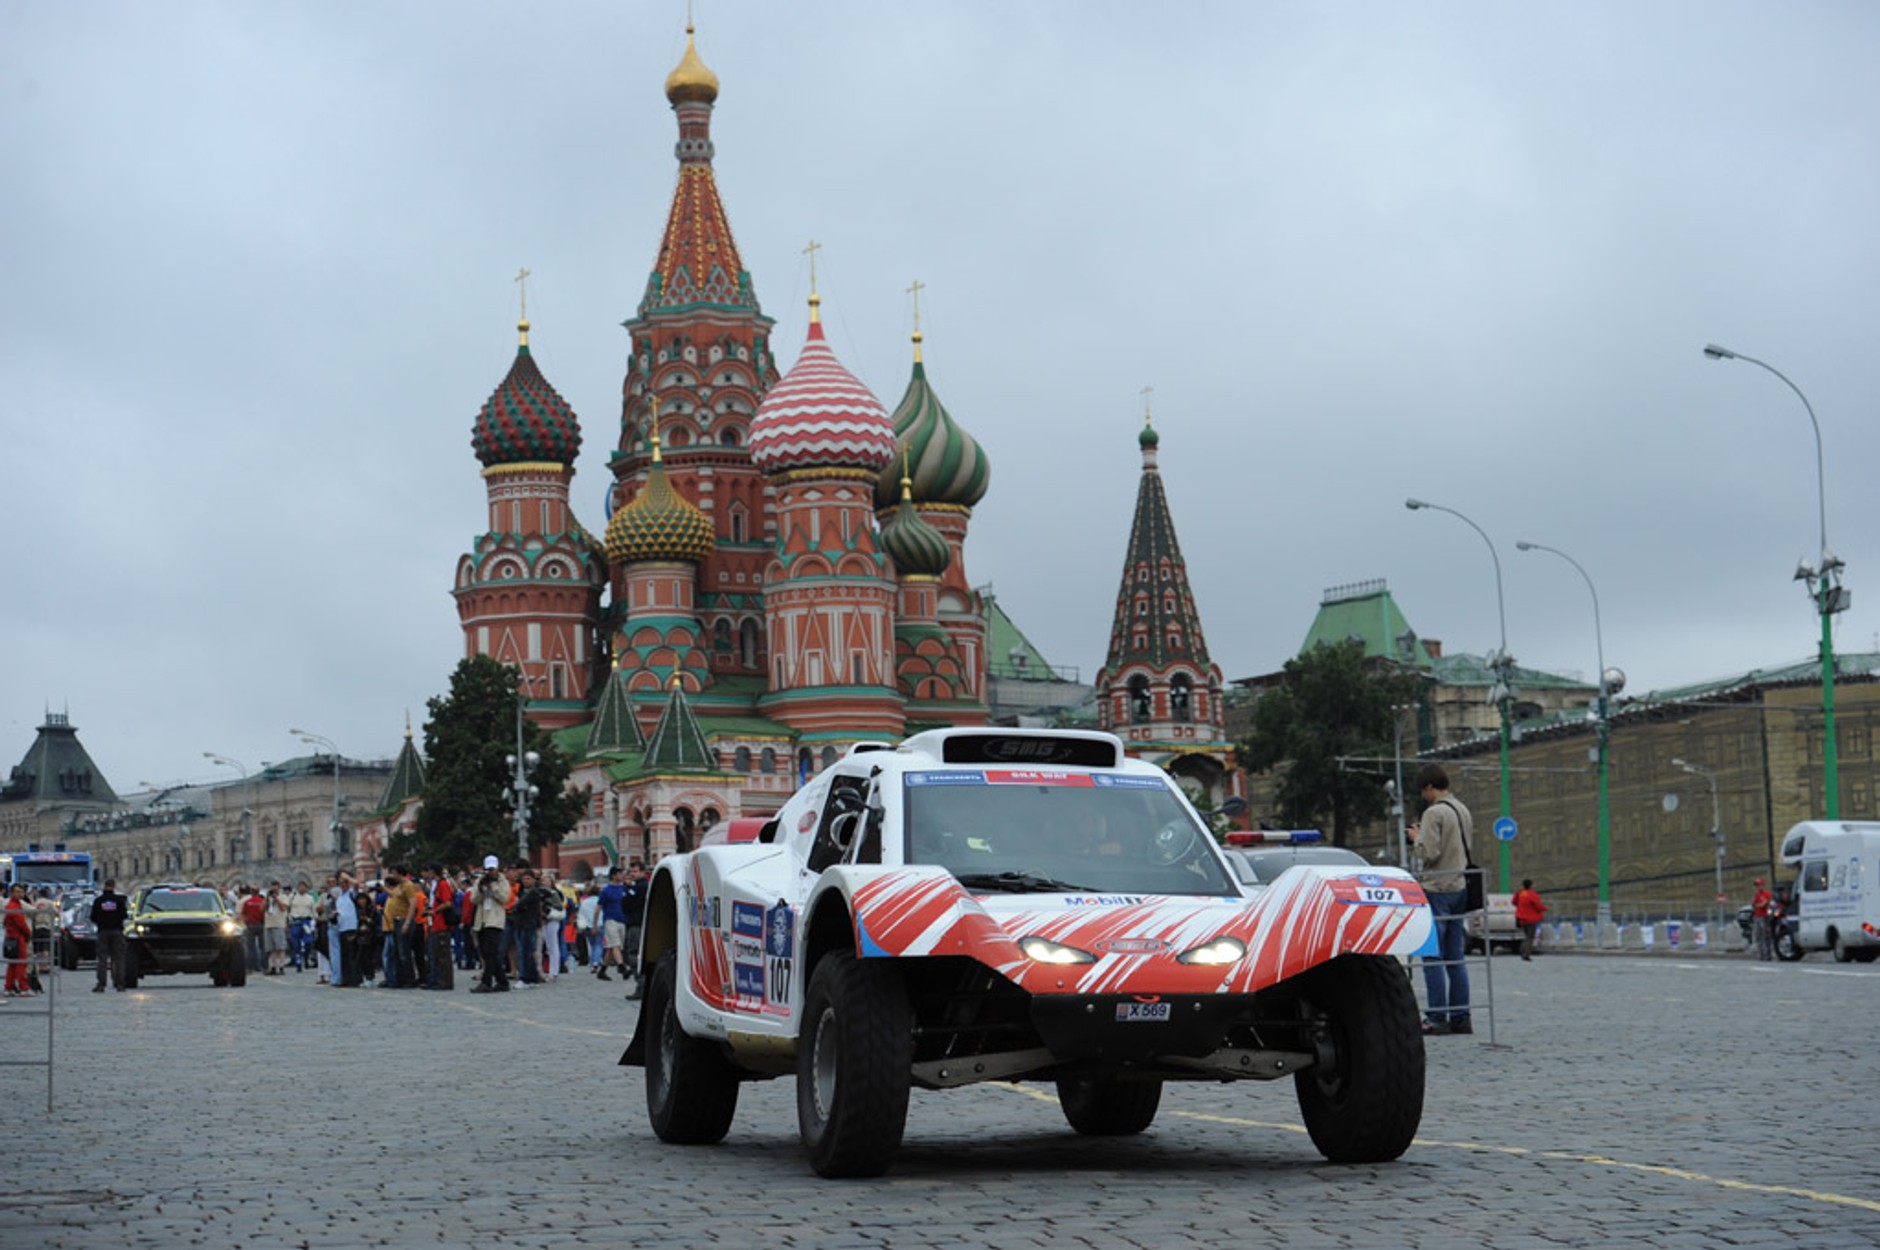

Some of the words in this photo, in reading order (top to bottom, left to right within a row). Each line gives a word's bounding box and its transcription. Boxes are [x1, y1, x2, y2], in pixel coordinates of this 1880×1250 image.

[999, 741, 1057, 756] SMG
[1366, 889, 1394, 901] 107
[770, 958, 791, 1004] 107
[1129, 1004, 1139, 1017] X
[1141, 1004, 1168, 1017] 569
